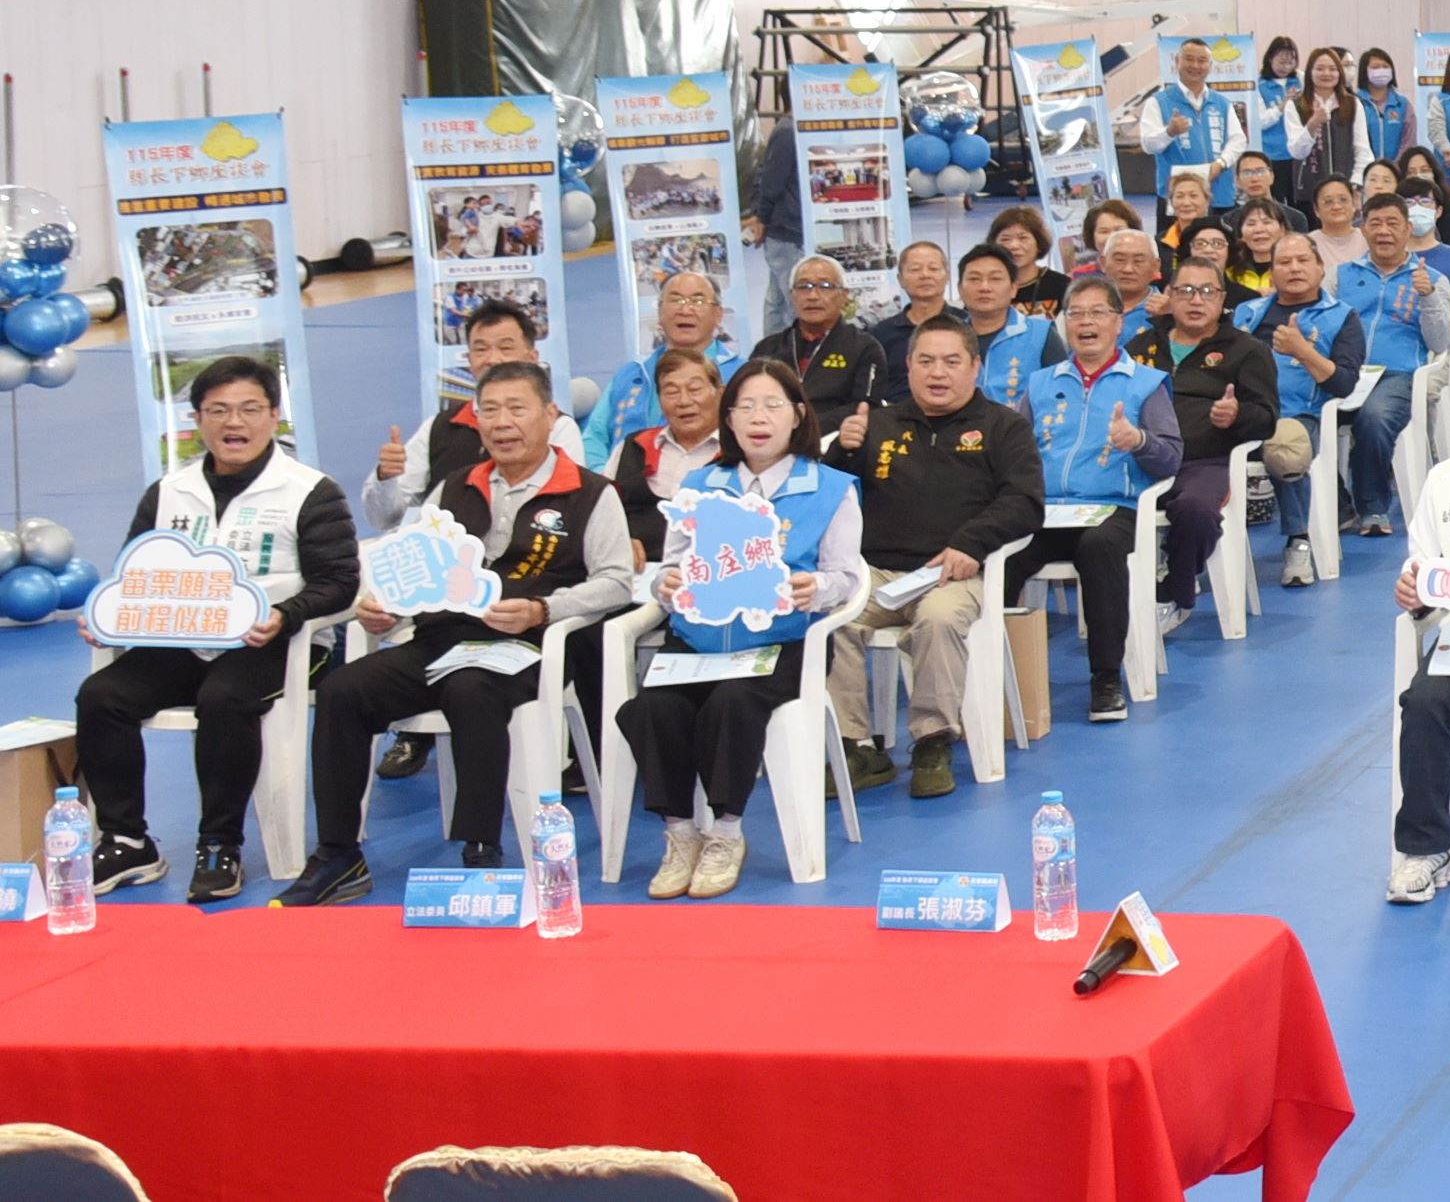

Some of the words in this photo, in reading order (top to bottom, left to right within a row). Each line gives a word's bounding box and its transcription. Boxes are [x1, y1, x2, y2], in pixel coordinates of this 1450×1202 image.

[127, 144, 194, 164] 115年度
[685, 537, 776, 586] 南庄鄉
[121, 568, 234, 600] 苗栗願景
[115, 603, 229, 636] 前程似錦
[448, 893, 517, 917] 邱鎮軍
[917, 897, 988, 922] 張淑芬
